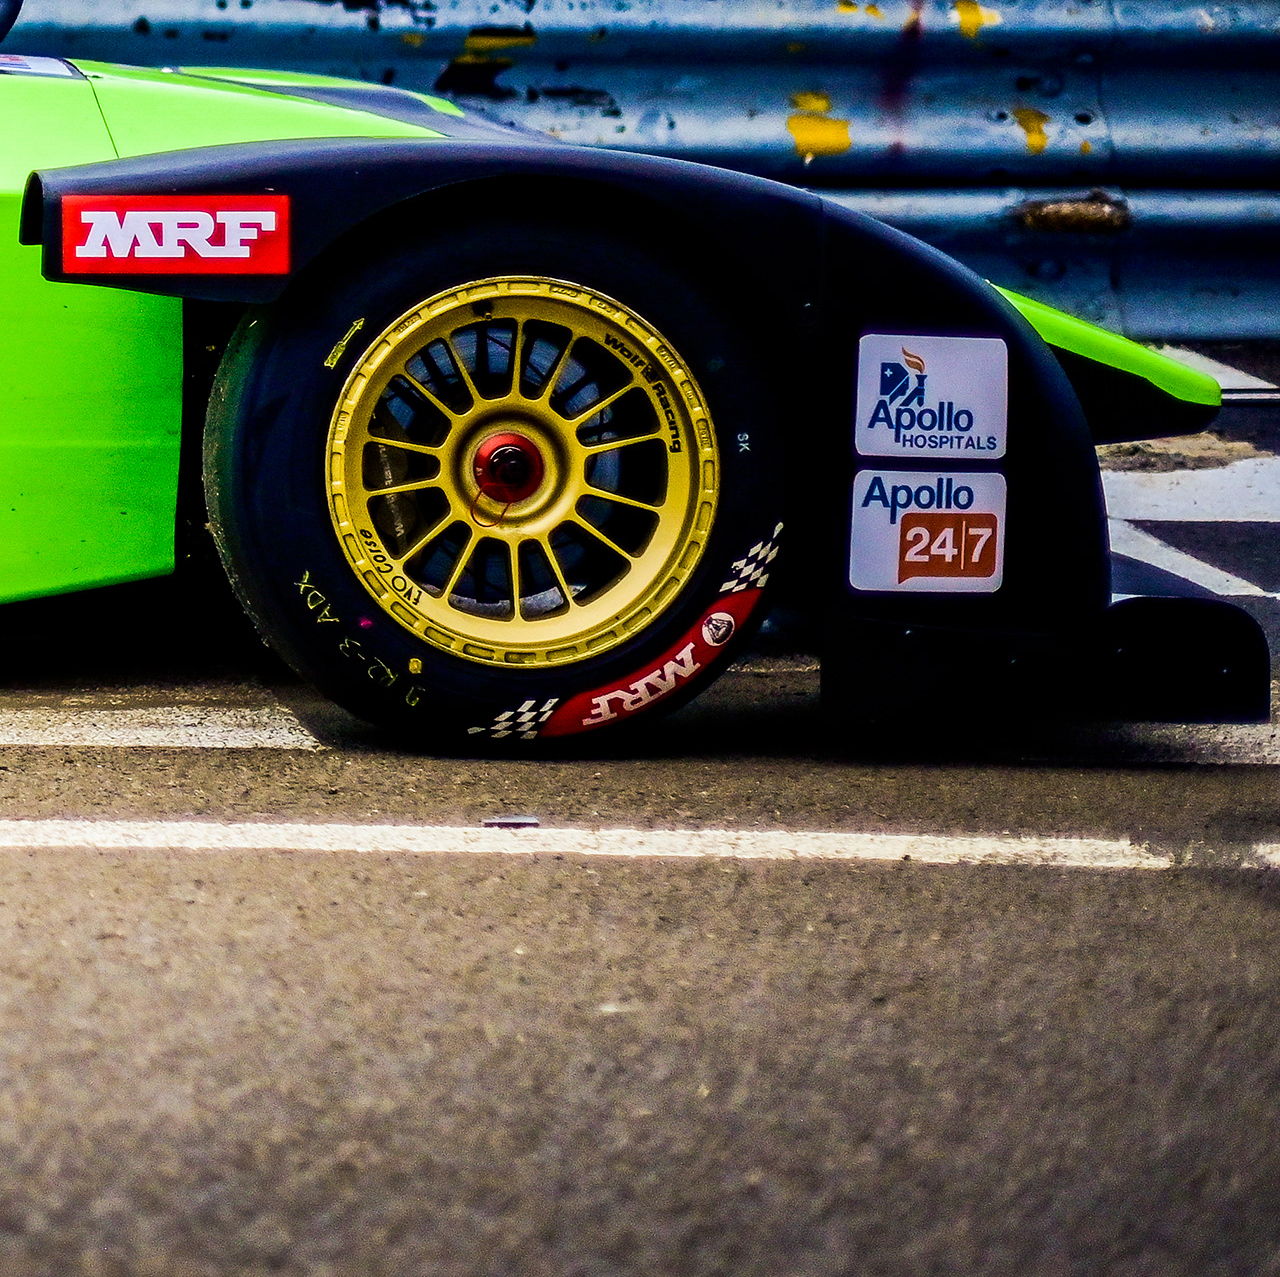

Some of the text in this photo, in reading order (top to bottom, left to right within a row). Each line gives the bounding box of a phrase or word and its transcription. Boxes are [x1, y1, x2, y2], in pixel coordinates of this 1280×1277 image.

[75, 211, 276, 258] MRF
[604, 333, 646, 368] Wolf
[652, 382, 682, 453] Racing
[867, 399, 974, 443] Apollo
[902, 434, 997, 450] HOSPITALS
[861, 476, 974, 525] Apollo
[360, 528, 393, 573] Corse
[582, 642, 701, 726] MRF
